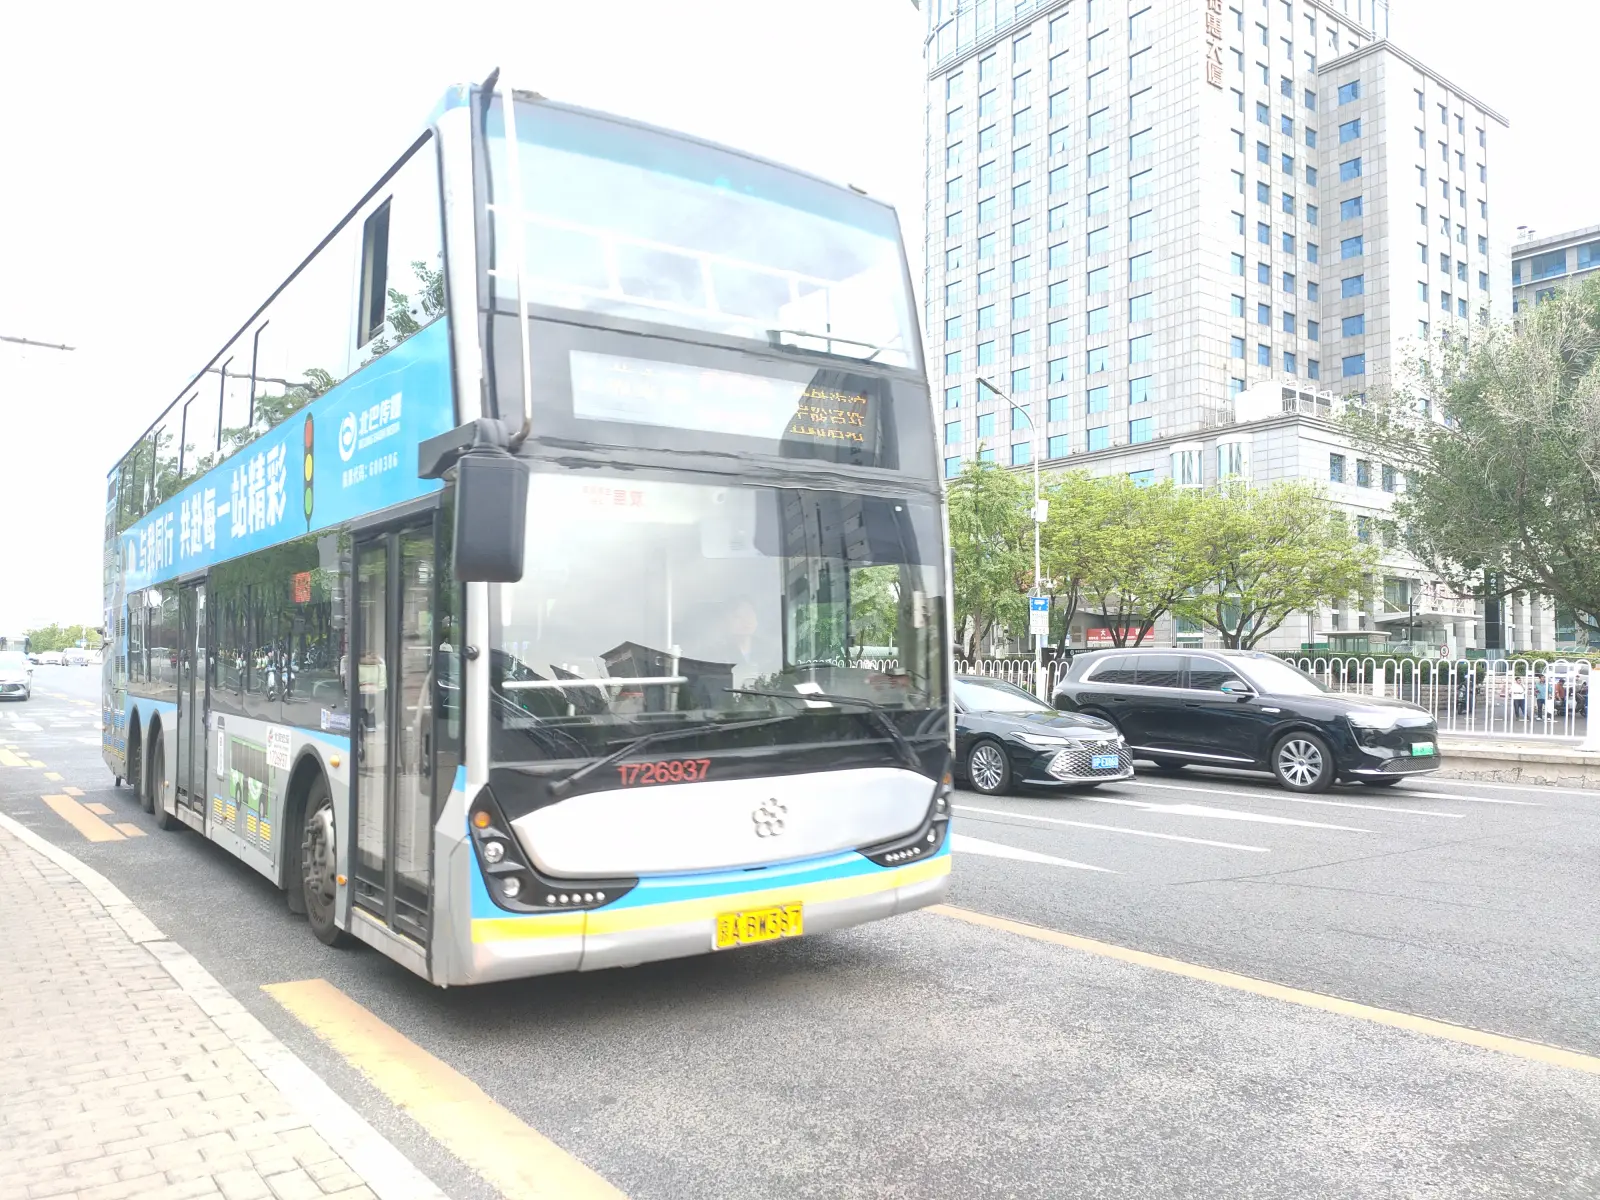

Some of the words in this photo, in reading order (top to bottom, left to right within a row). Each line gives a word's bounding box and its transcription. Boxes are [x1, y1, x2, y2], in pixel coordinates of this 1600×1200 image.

[139, 511, 174, 580] 与我同行
[180, 442, 287, 560] 共赴每一站精彩
[617, 758, 711, 786] 1726937
